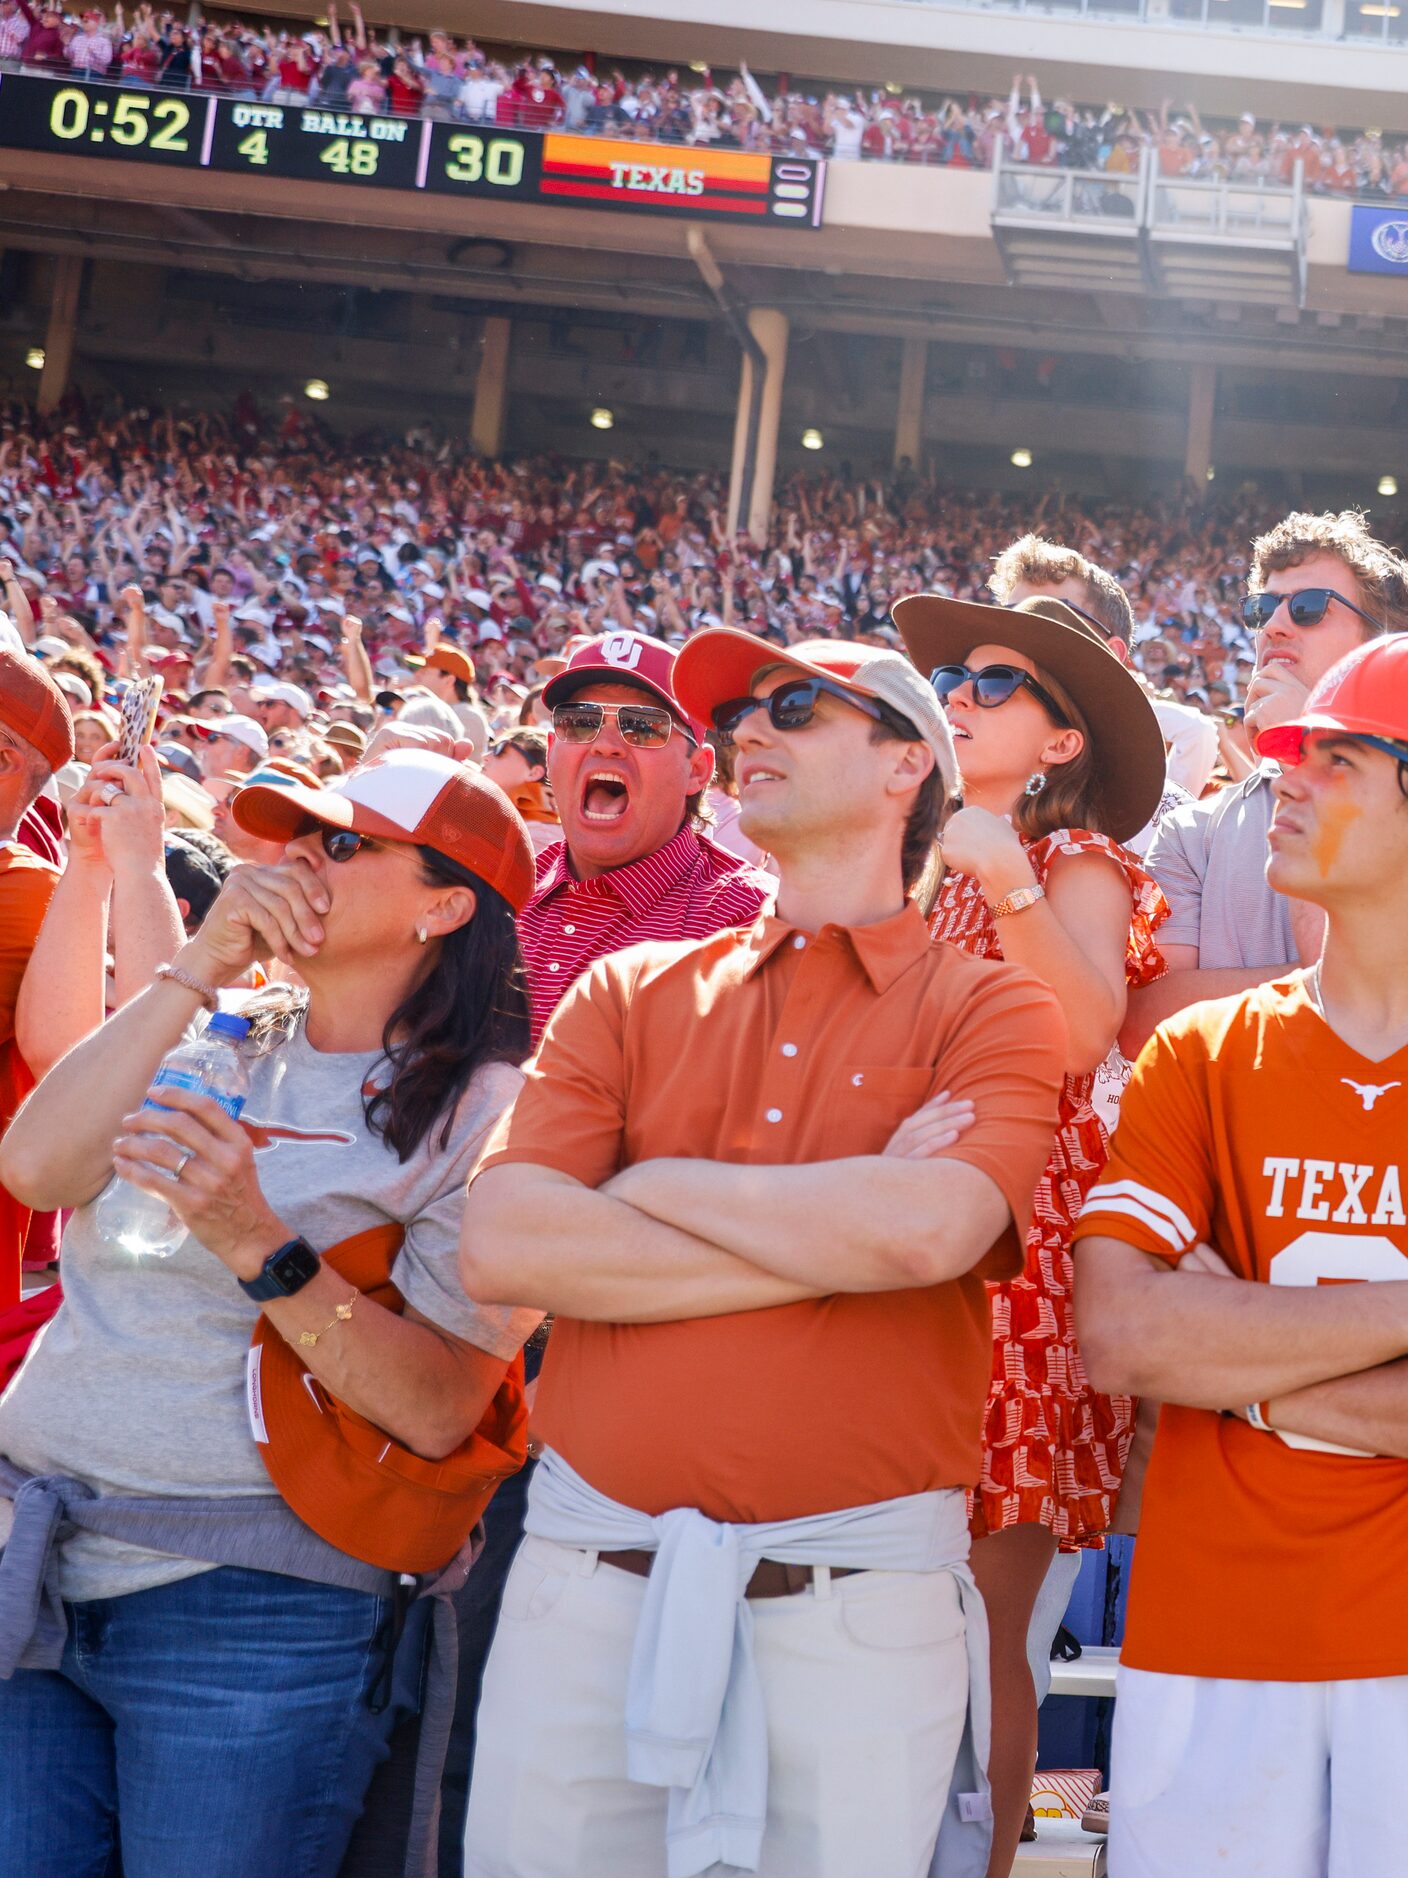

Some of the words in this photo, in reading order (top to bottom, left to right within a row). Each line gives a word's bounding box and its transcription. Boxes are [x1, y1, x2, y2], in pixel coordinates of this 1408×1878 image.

[50, 88, 190, 152] 0:52
[232, 103, 284, 130] QTR
[302, 112, 367, 138] BALL
[368, 117, 408, 142] ON
[238, 129, 268, 165] 4
[319, 138, 379, 176] 48
[445, 133, 525, 186] 30
[609, 161, 705, 196] TEXAS
